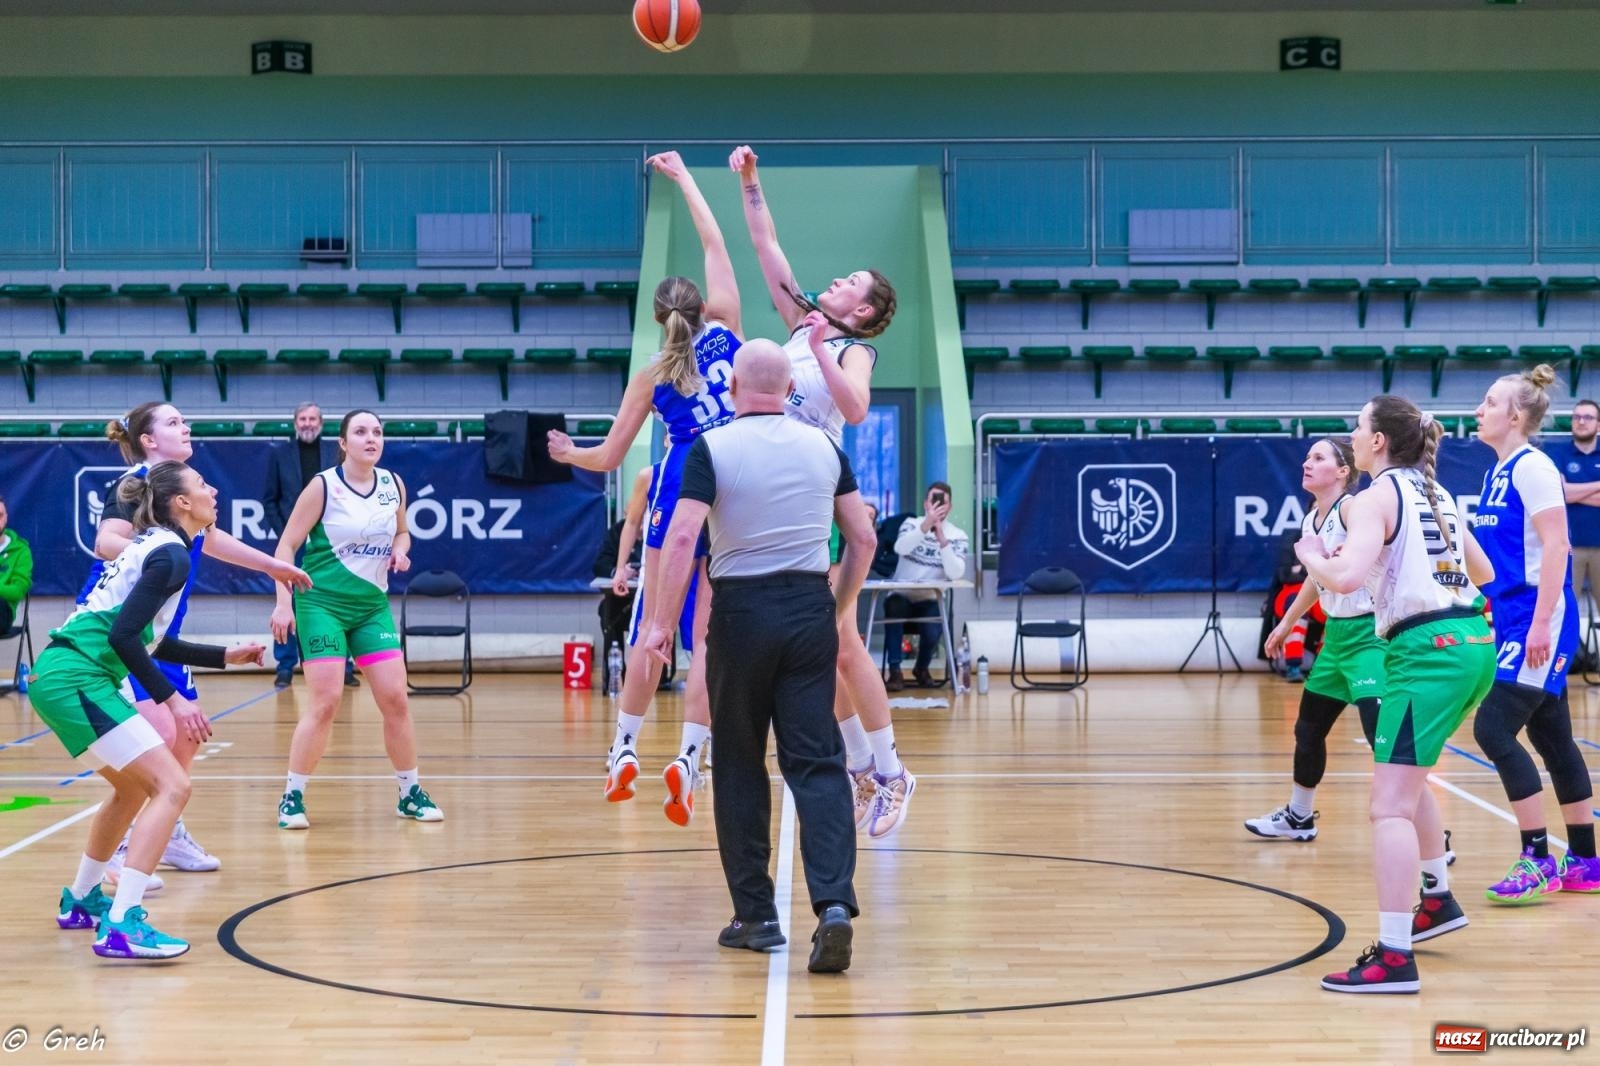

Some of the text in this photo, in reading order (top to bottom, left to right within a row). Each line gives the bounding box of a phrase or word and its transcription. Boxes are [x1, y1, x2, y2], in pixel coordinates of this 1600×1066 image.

[257, 52, 271, 71] B
[284, 51, 305, 70] B
[1286, 47, 1308, 67] C
[1321, 47, 1336, 67] C
[378, 490, 400, 506] 24
[1486, 477, 1509, 507] 22
[352, 543, 392, 557] Clavis
[309, 634, 339, 654] 24
[568, 646, 587, 679] 5
